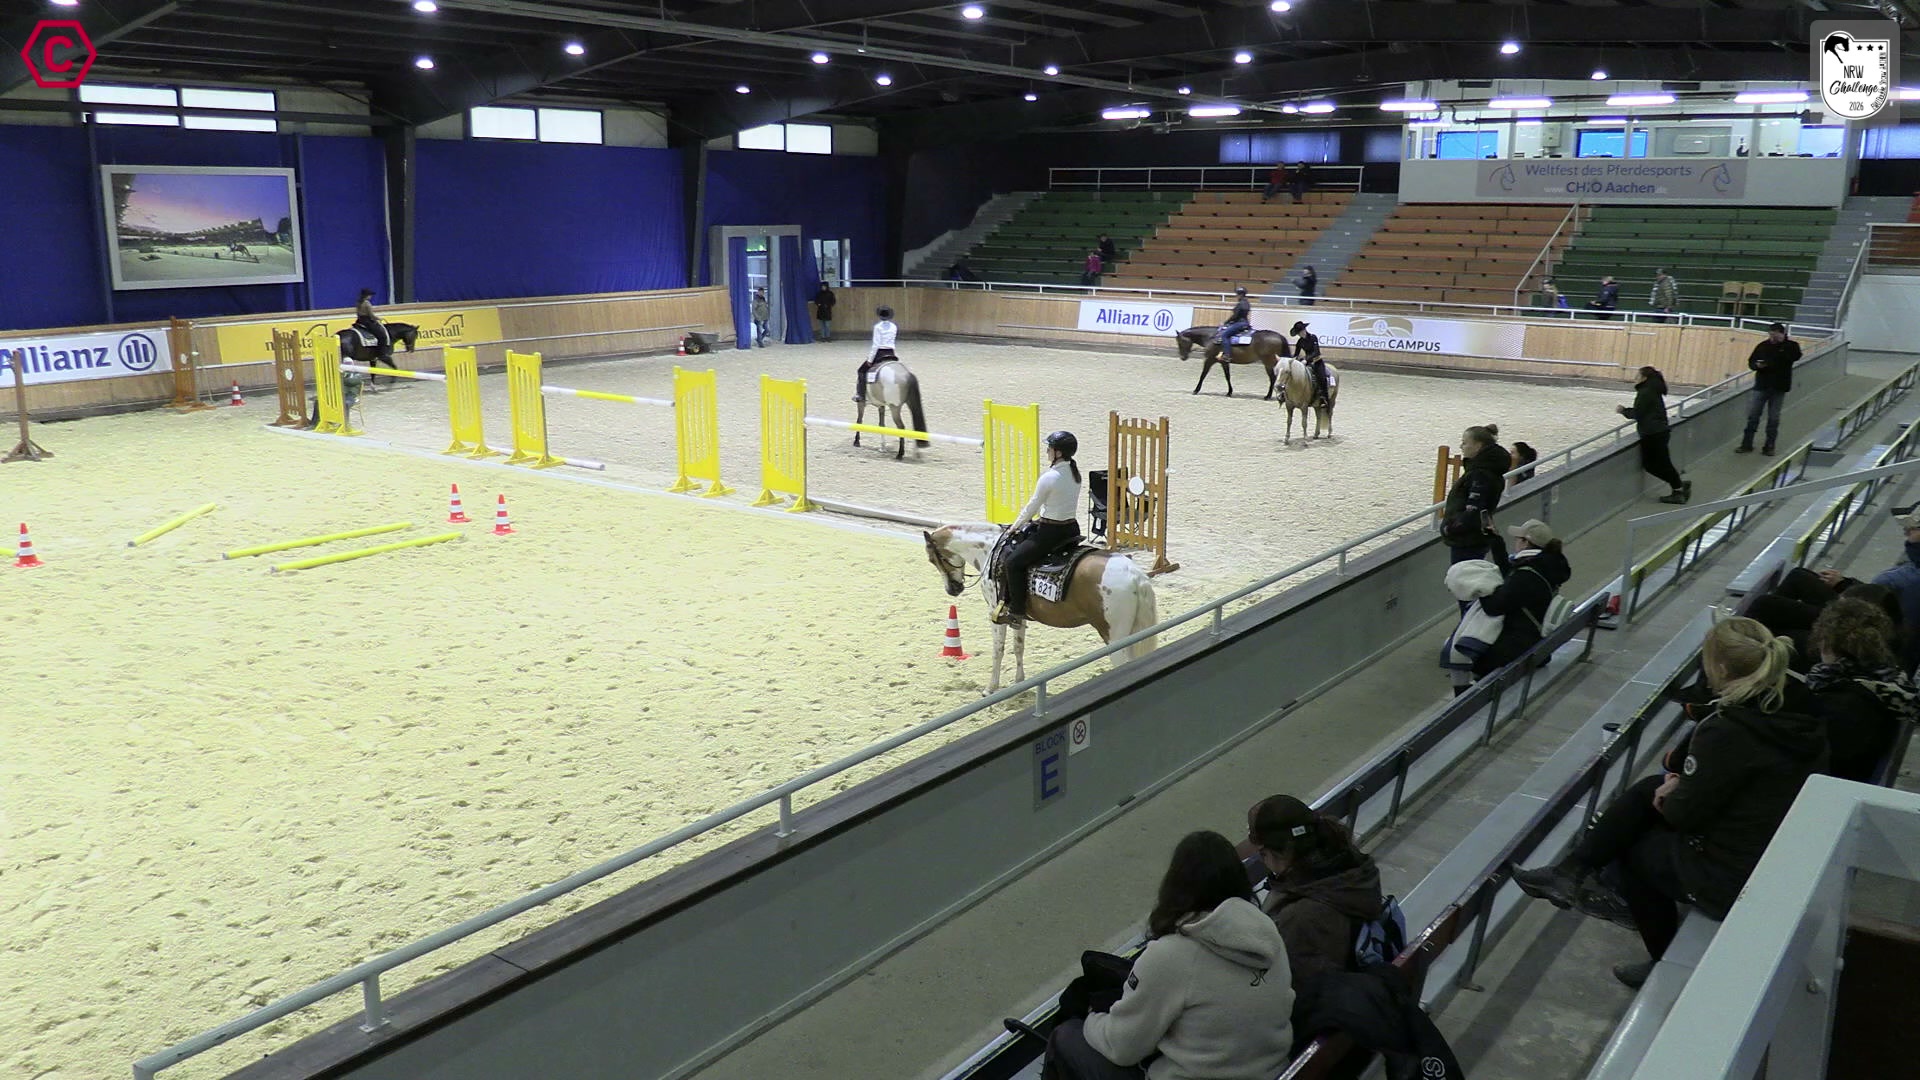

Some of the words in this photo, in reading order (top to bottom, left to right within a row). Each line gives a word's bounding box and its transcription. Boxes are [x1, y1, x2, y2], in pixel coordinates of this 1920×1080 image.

[1526, 164, 1578, 175] Weltfest
[1581, 164, 1603, 175] des
[1607, 164, 1692, 178] Pferdesports
[1605, 181, 1655, 193] Aachen
[1096, 308, 1150, 326] Allianz
[1318, 335, 1347, 346] CHIO
[1349, 338, 1386, 349] Aachen
[1388, 339, 1441, 351] CAMPUS
[1038, 581, 1052, 597] 821
[1035, 729, 1065, 754] BLOCK
[1041, 752, 1060, 800] E
